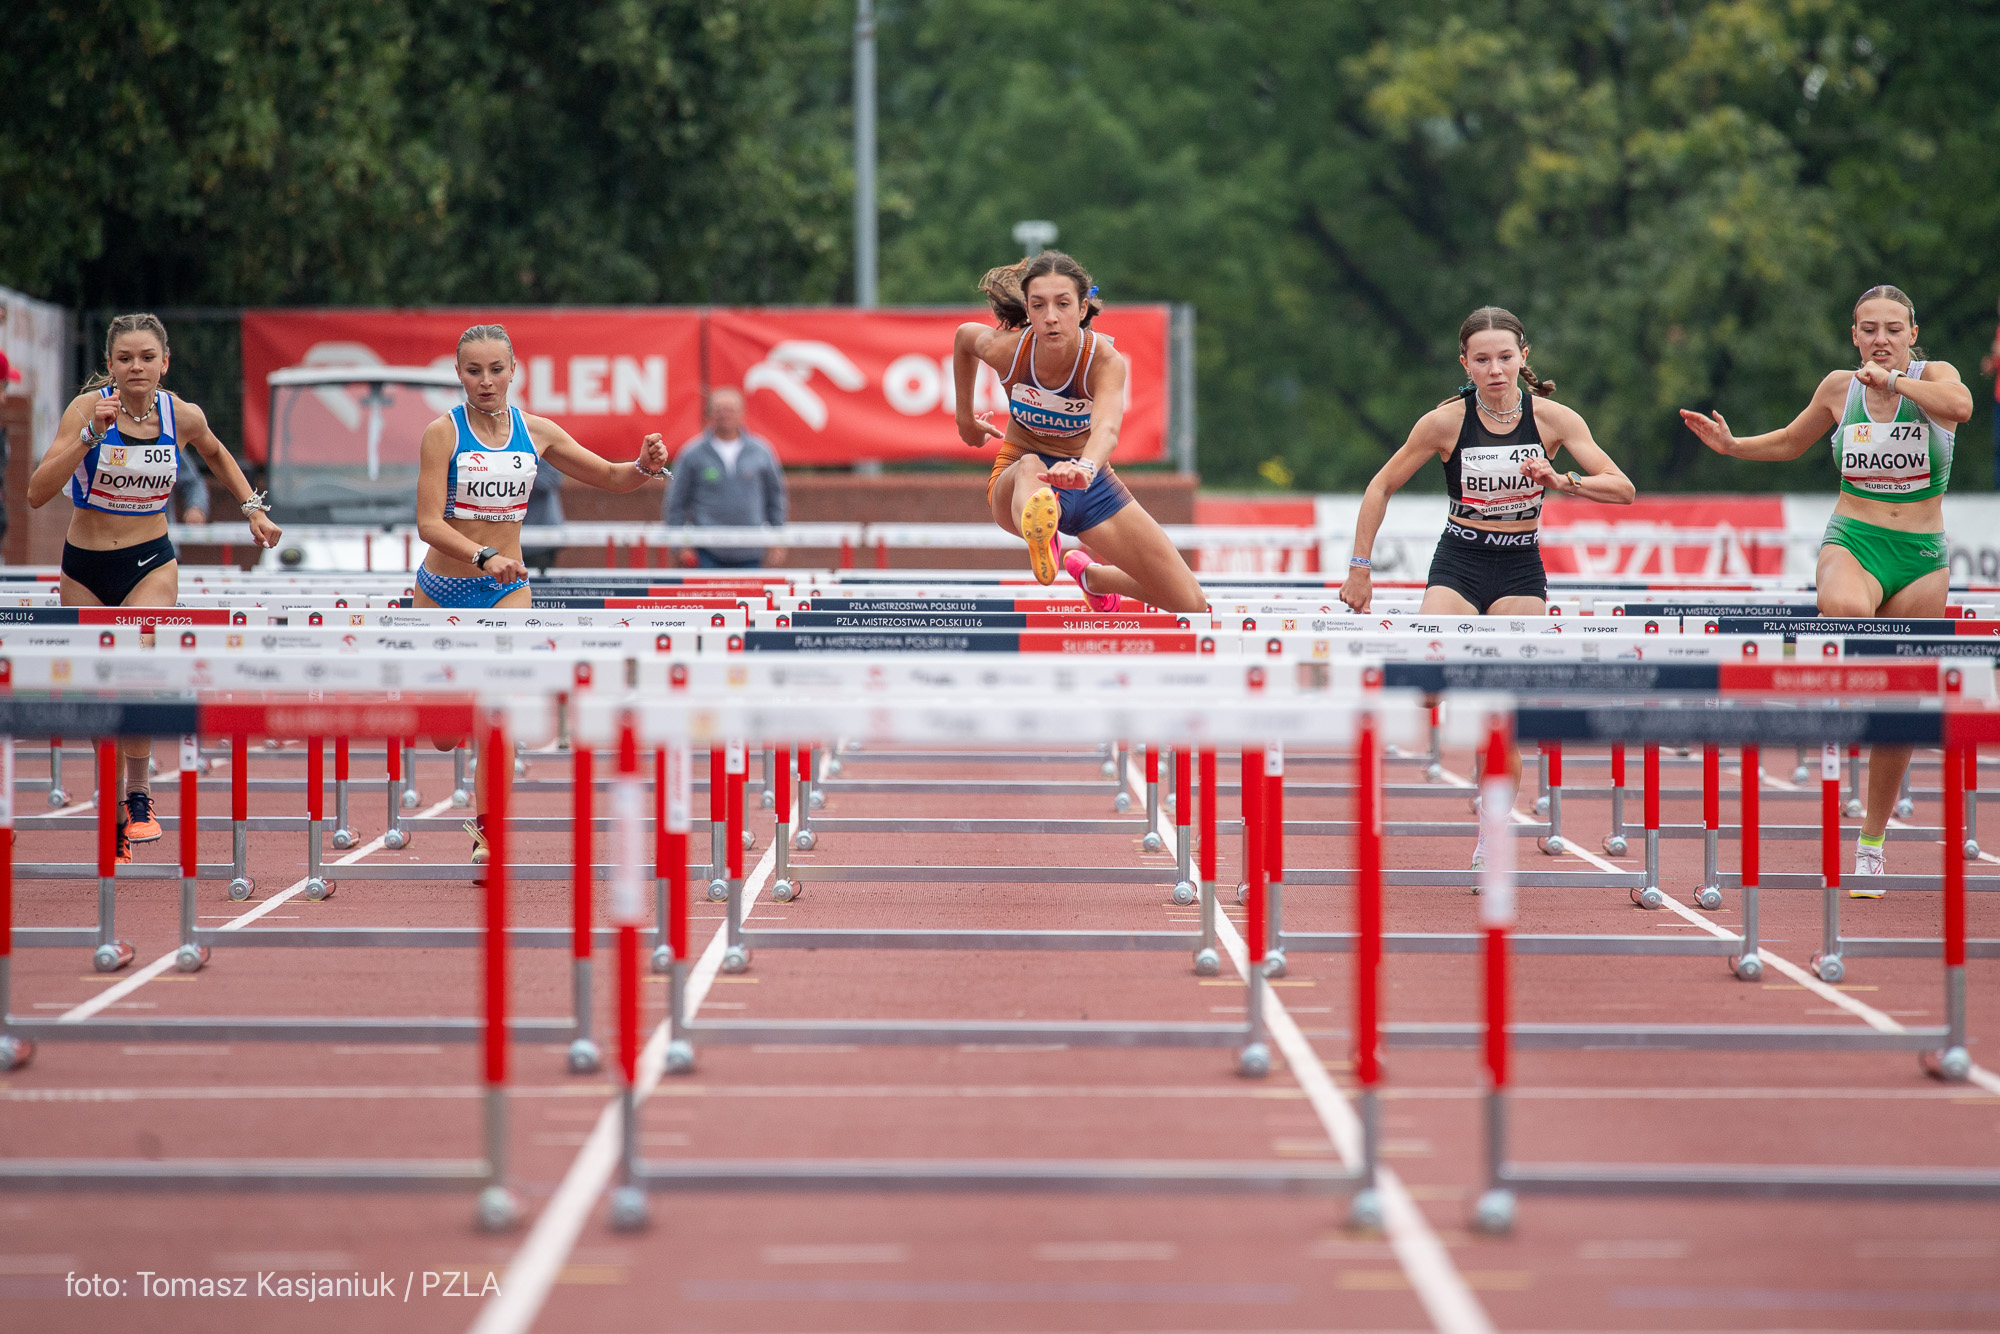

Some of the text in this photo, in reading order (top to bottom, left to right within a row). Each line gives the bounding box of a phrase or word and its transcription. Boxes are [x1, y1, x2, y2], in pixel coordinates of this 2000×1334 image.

[1021, 398, 1042, 407] ORLEN
[1064, 402, 1085, 412] 29
[1890, 426, 1921, 440] 474
[144, 449, 171, 463] 505
[1846, 453, 1925, 469] DRAGOW
[513, 456, 522, 469] 3
[99, 472, 173, 489] DOMNIK
[1864, 482, 1892, 490] SŁUBICE
[467, 481, 526, 497] KICUŁA
[1480, 504, 1509, 513] SŁUBICE
[1510, 502, 1527, 510] 2023
[473, 513, 516, 521] SŁUBICE 2023
[1484, 533, 1532, 546] NIKE
[849, 602, 977, 611] PZLA MISTRZOSTWA POLSKI U16
[1663, 607, 1792, 616] PZLA MISTRZOSTWA POLSKI U16
[15, 613, 35, 622] U16
[115, 616, 193, 627] SŁUBICE 2023
[836, 617, 983, 628] PZLA MISTRZOSTWA POLSKI U16
[1063, 621, 1140, 631] SŁUBICE 2023
[1417, 625, 1443, 633] FUEL
[1763, 622, 1911, 633] PZLA MISTRZOSTWA POLSKI U16
[824, 636, 904, 649] MISTRZOSTWA
[905, 636, 943, 649] POLSKI
[1121, 640, 1155, 653] 2023
[1896, 644, 1923, 655] PZLA
